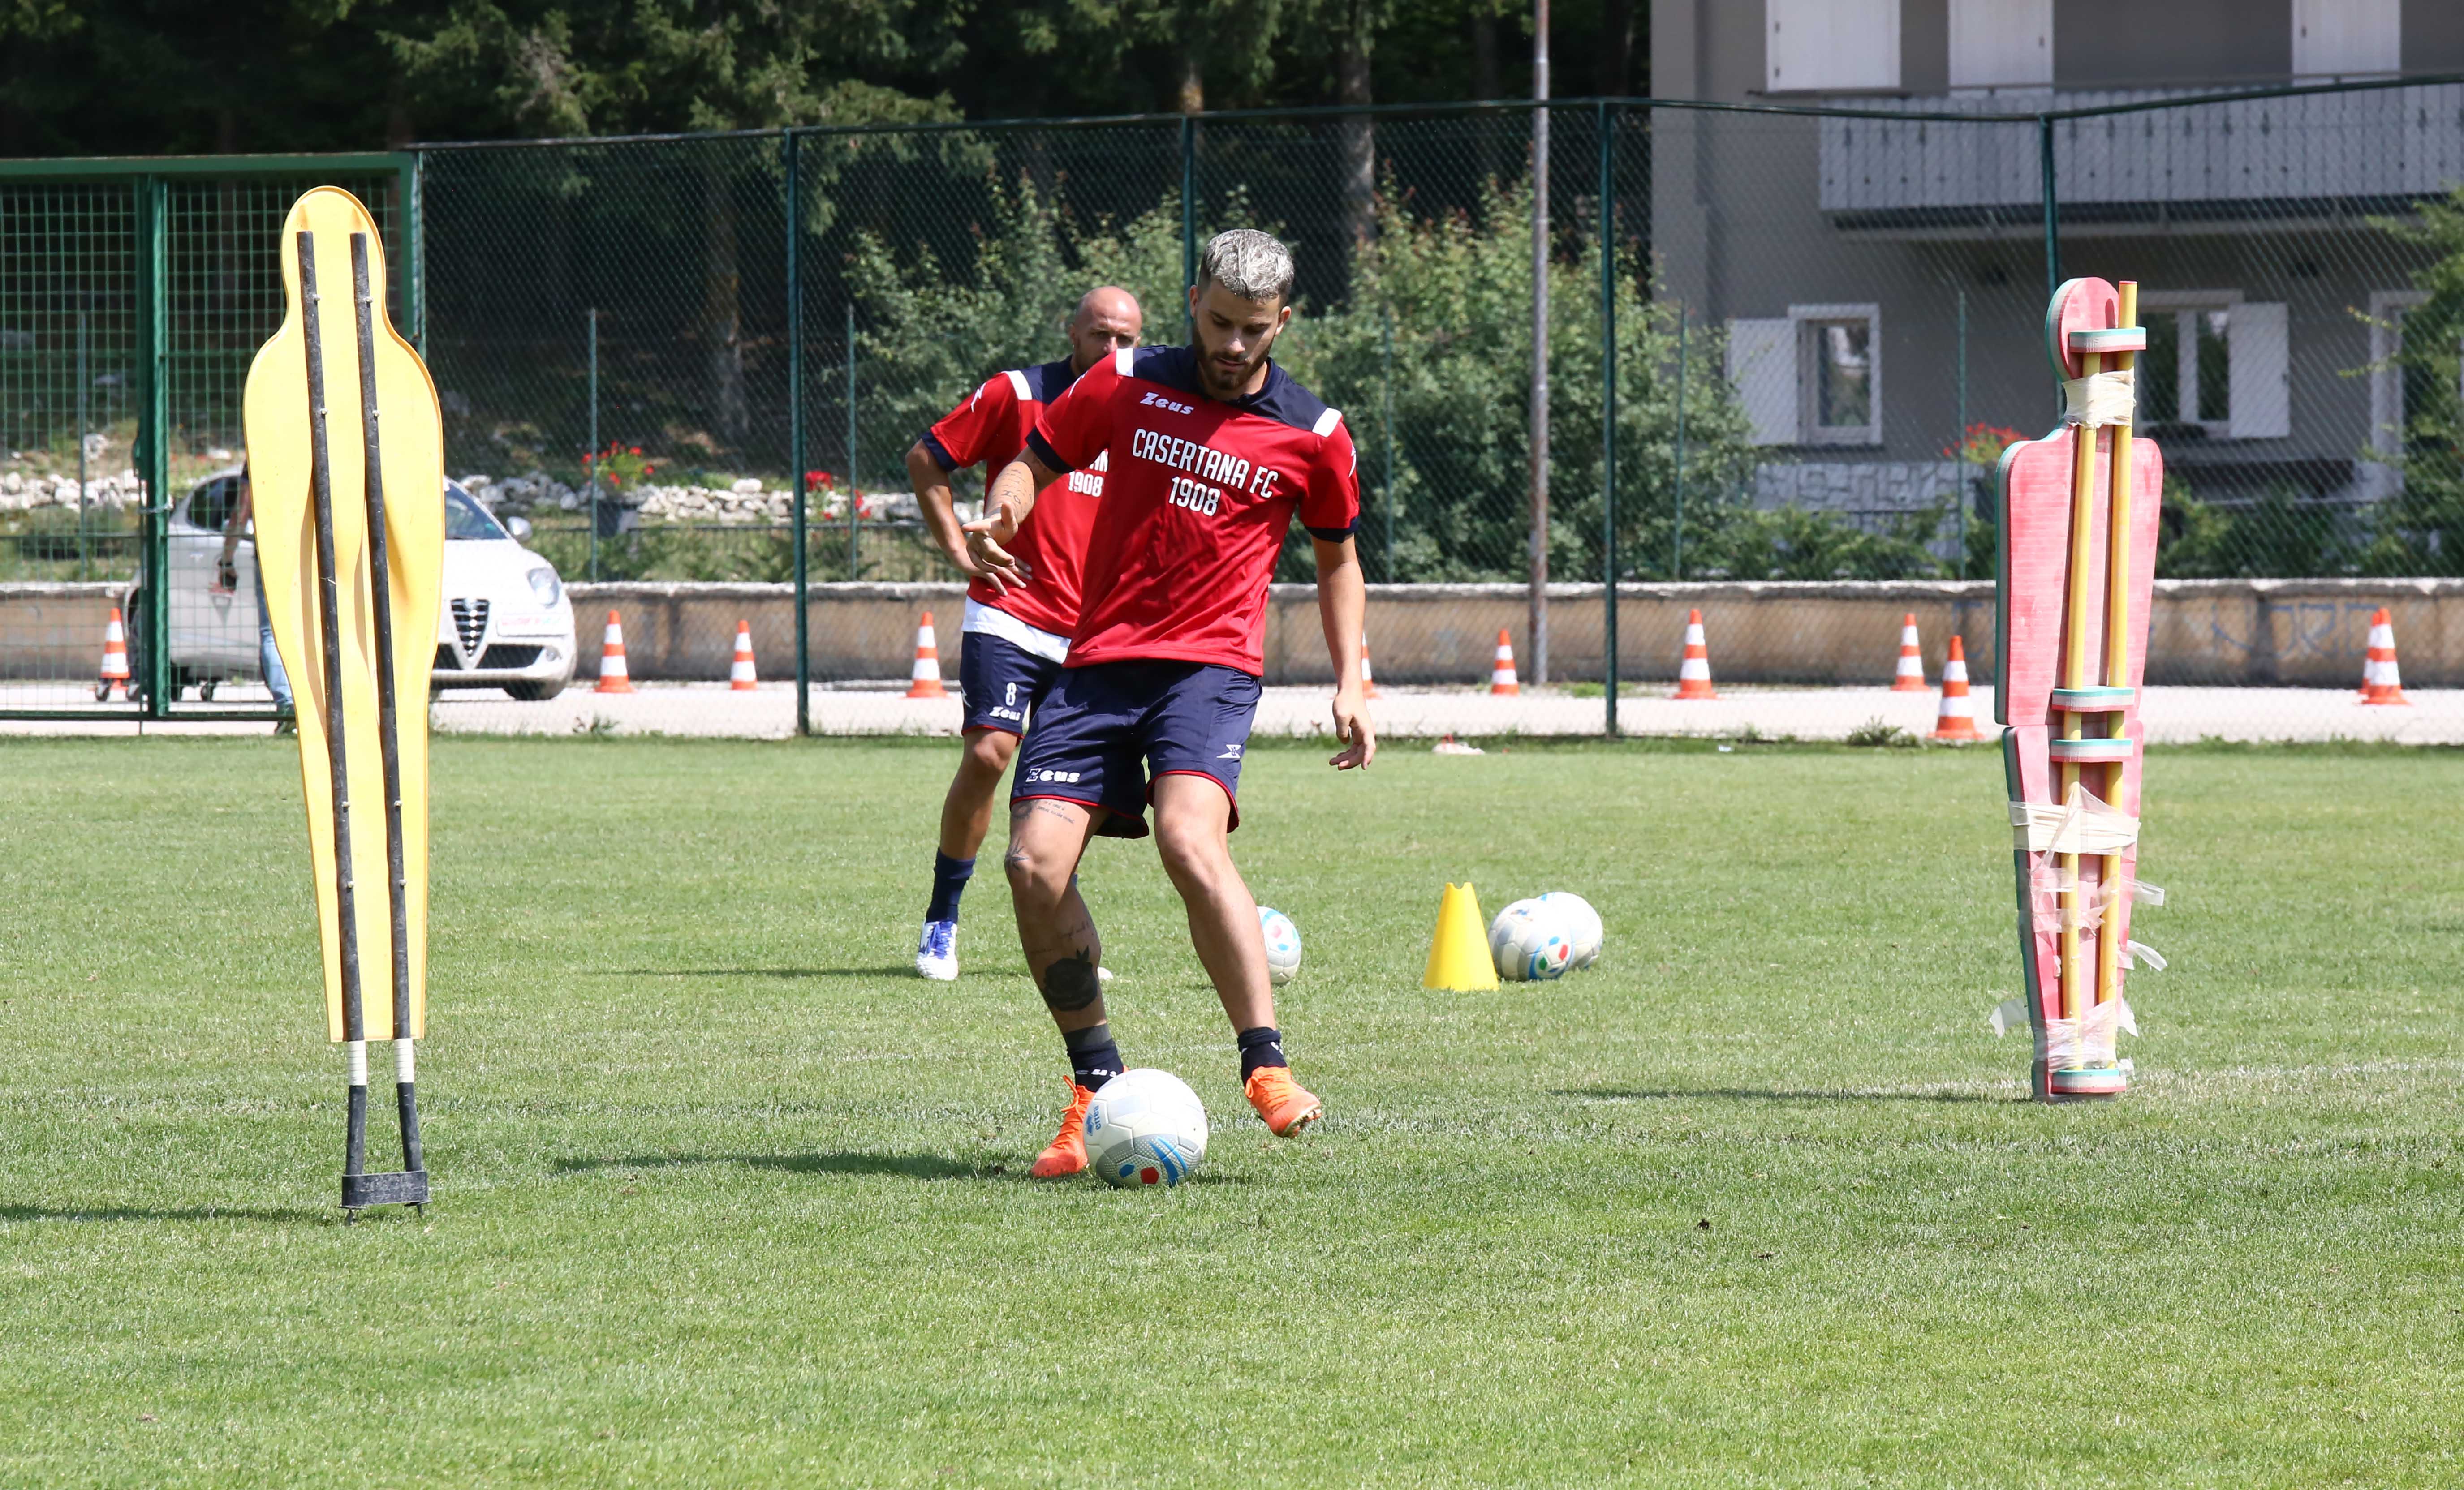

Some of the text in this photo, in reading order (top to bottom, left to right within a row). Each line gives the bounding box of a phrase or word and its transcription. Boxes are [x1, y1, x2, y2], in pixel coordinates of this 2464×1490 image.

[1140, 392, 1194, 415] Zeus
[1132, 428, 1250, 489] CASERTANA
[1249, 465, 1279, 498] FC
[1068, 471, 1104, 497] 1908
[1168, 476, 1221, 516] 1908
[1006, 682, 1017, 706] 8
[1025, 768, 1081, 783] Zeus
